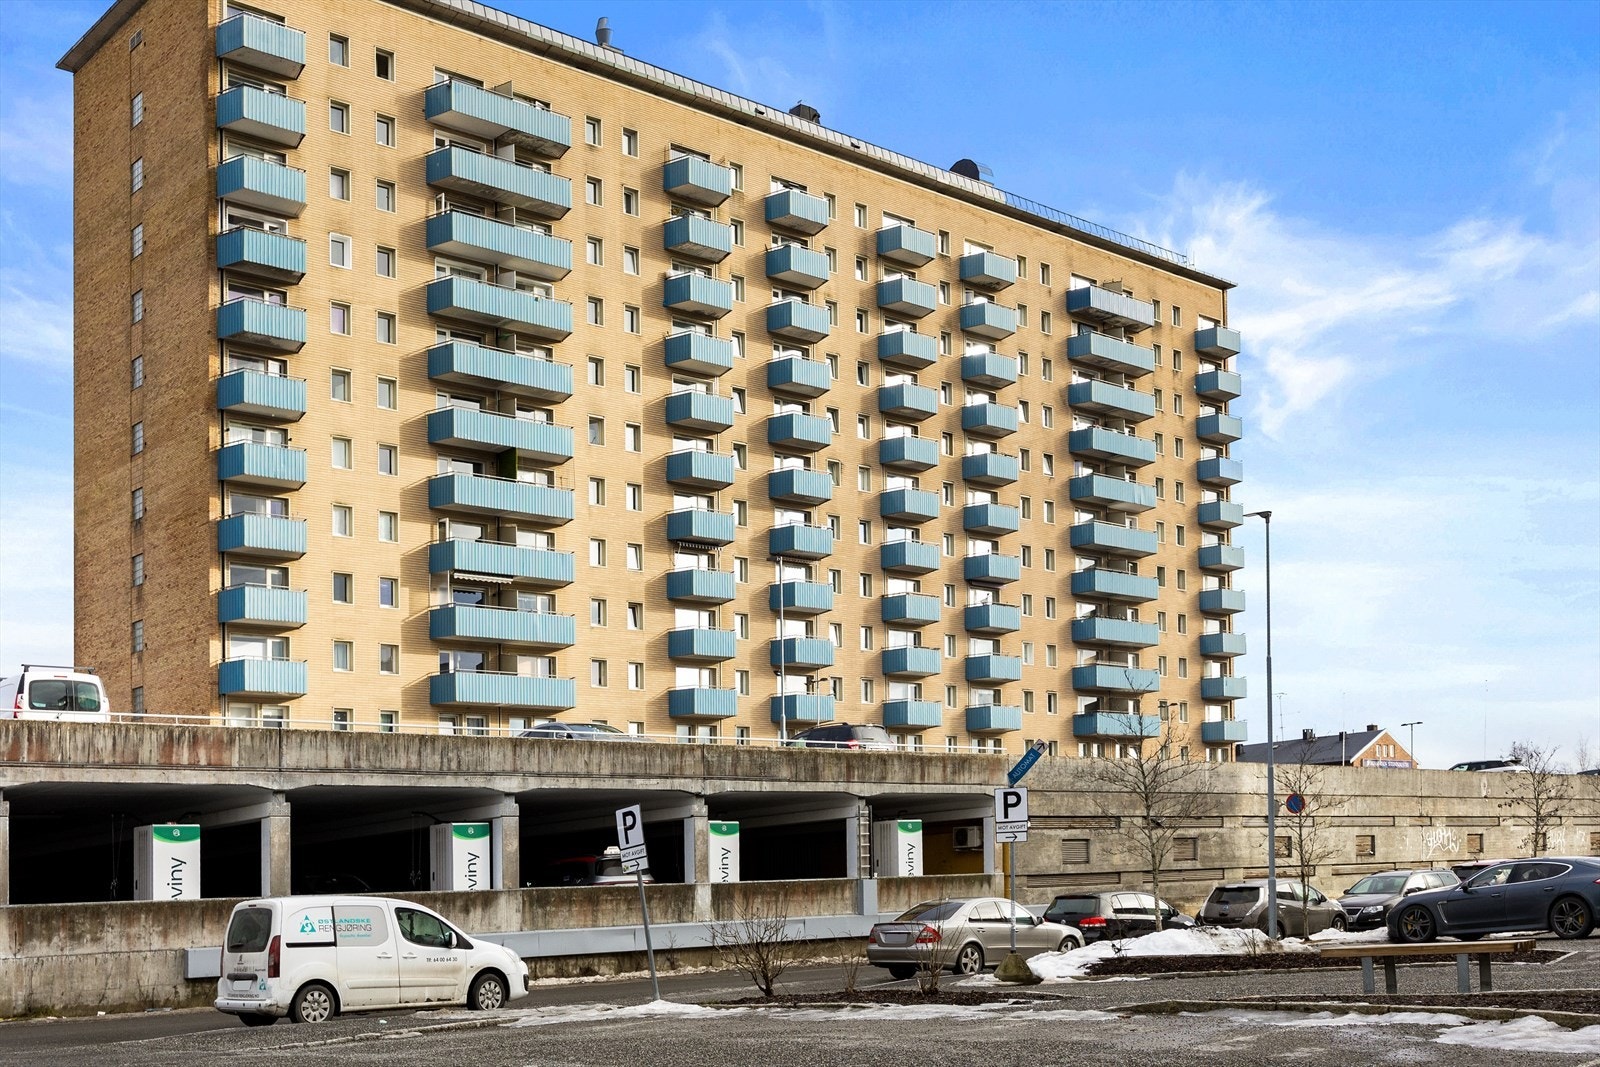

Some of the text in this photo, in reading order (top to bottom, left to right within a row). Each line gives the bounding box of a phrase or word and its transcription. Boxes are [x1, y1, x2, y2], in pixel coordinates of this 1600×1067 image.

[1012, 753, 1035, 778] AUTOMAT
[1003, 791, 1021, 819] P
[622, 810, 637, 845] P
[631, 848, 645, 856] AVGIFT
[719, 847, 731, 882] viny
[167, 857, 187, 900] viny
[465, 852, 480, 890] viny
